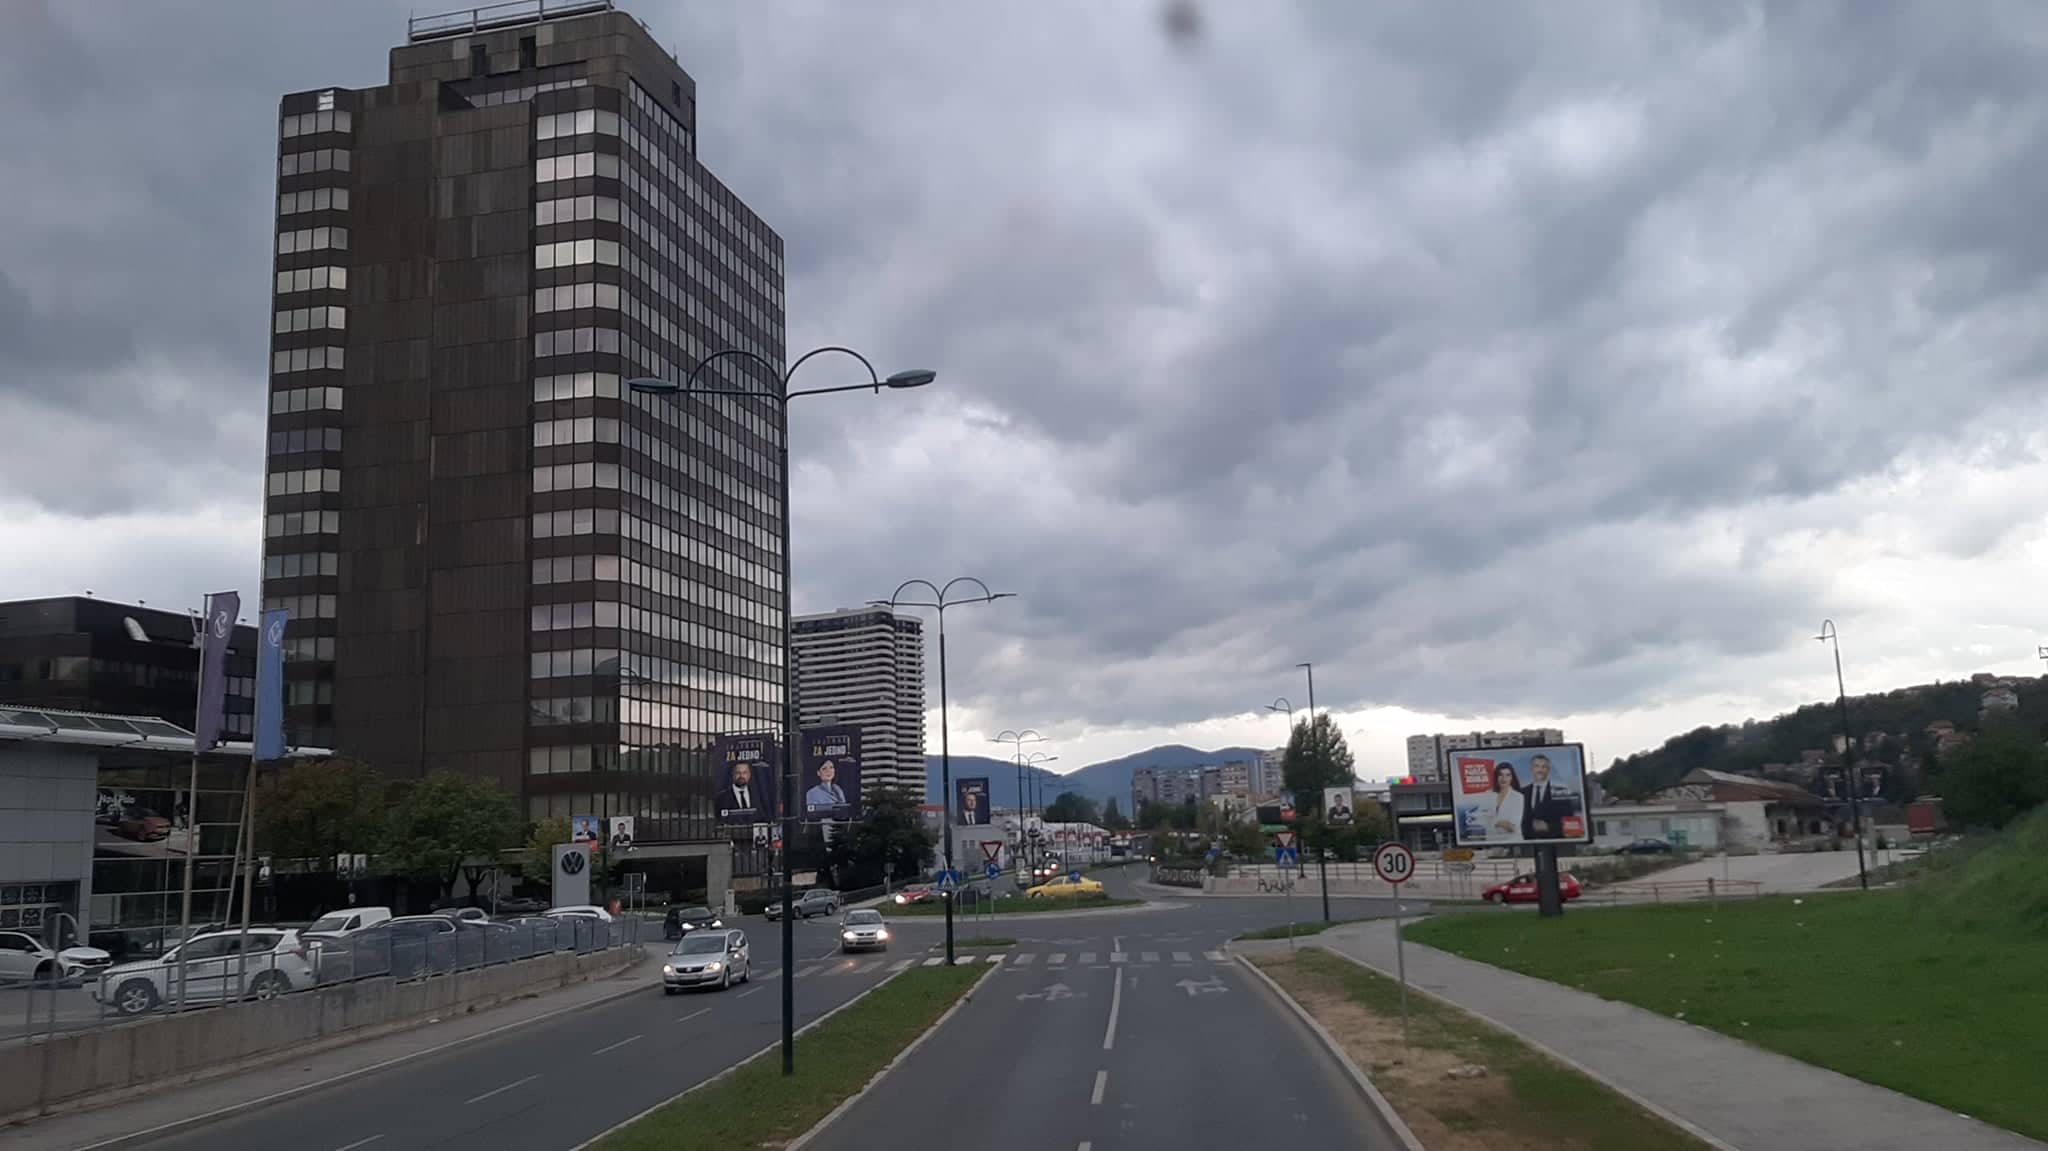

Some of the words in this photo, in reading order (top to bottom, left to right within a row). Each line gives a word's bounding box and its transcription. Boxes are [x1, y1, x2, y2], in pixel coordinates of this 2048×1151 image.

[726, 751, 736, 761] ZA
[813, 745, 823, 757] ZA
[1383, 853, 1406, 873] 30
